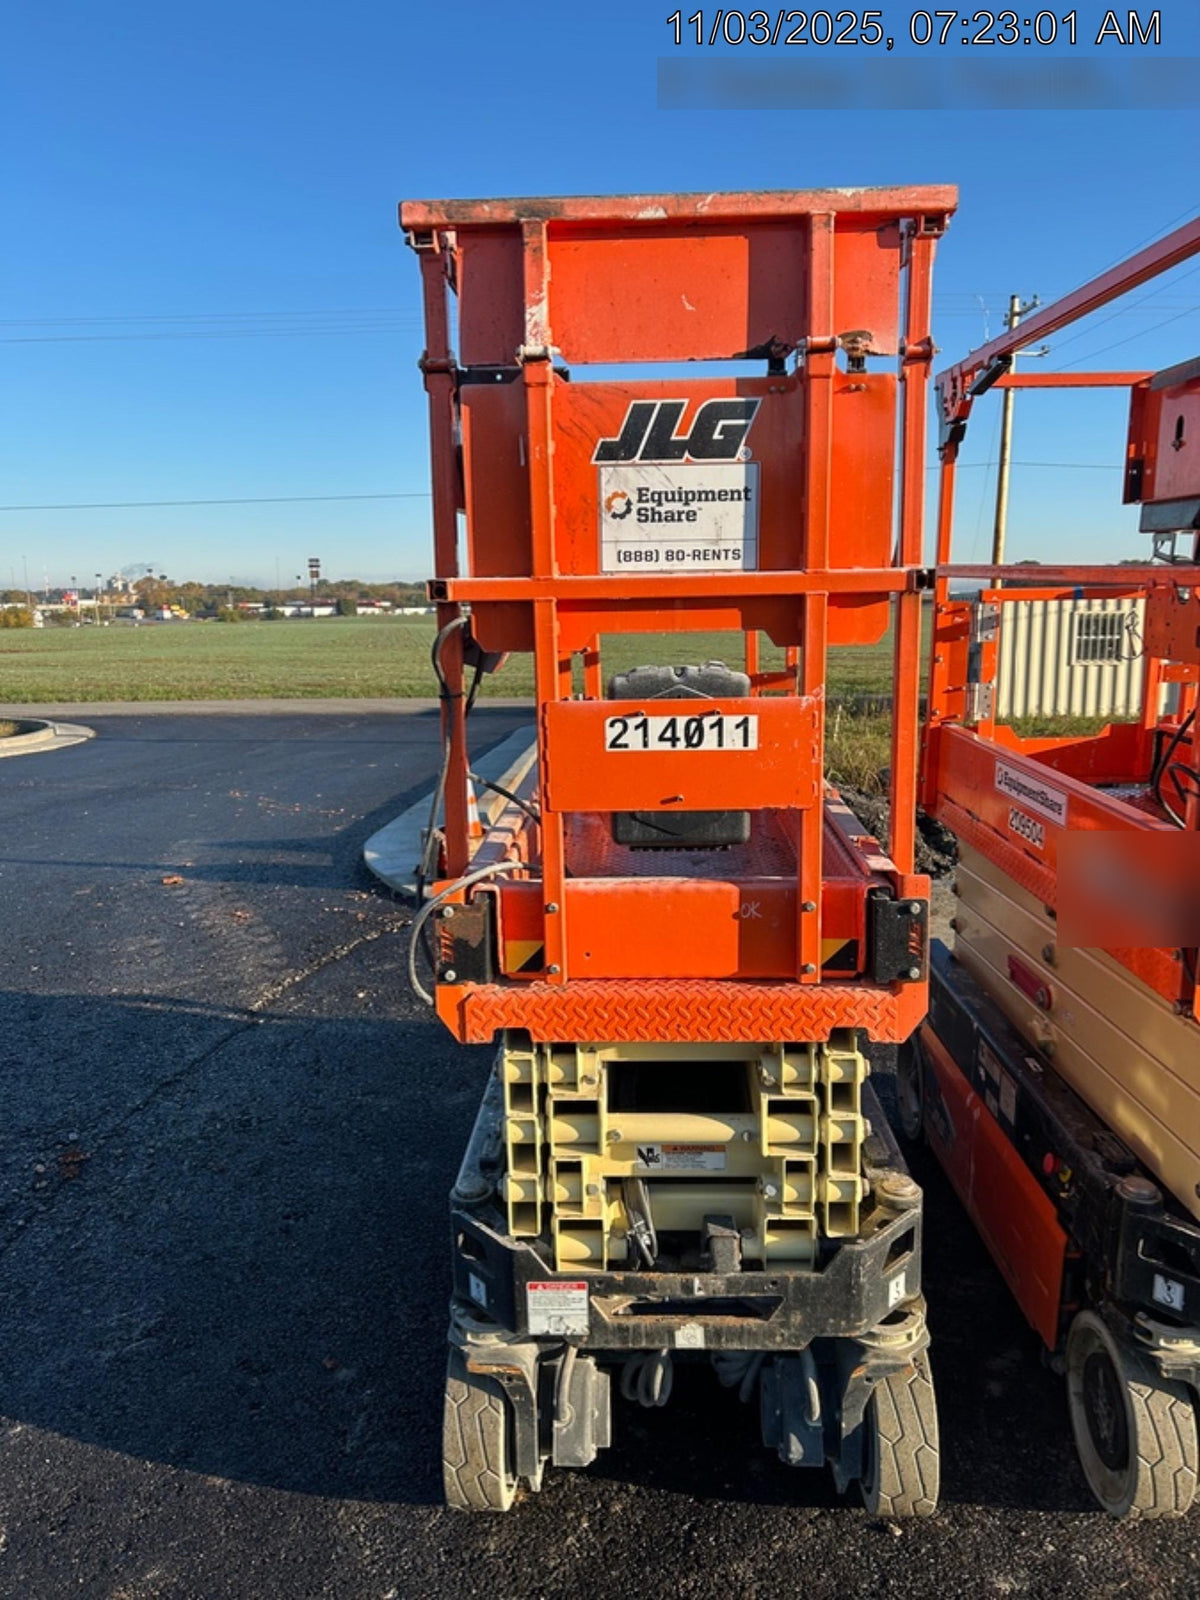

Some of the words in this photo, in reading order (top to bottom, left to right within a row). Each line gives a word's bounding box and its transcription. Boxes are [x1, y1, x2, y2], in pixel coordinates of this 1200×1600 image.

[591, 398, 761, 463] JLG
[636, 486, 751, 506] Equipment
[617, 549, 659, 563] (888)
[665, 548, 741, 562] 80-RENTS
[608, 716, 750, 748] 214011
[740, 902, 762, 918] OK
